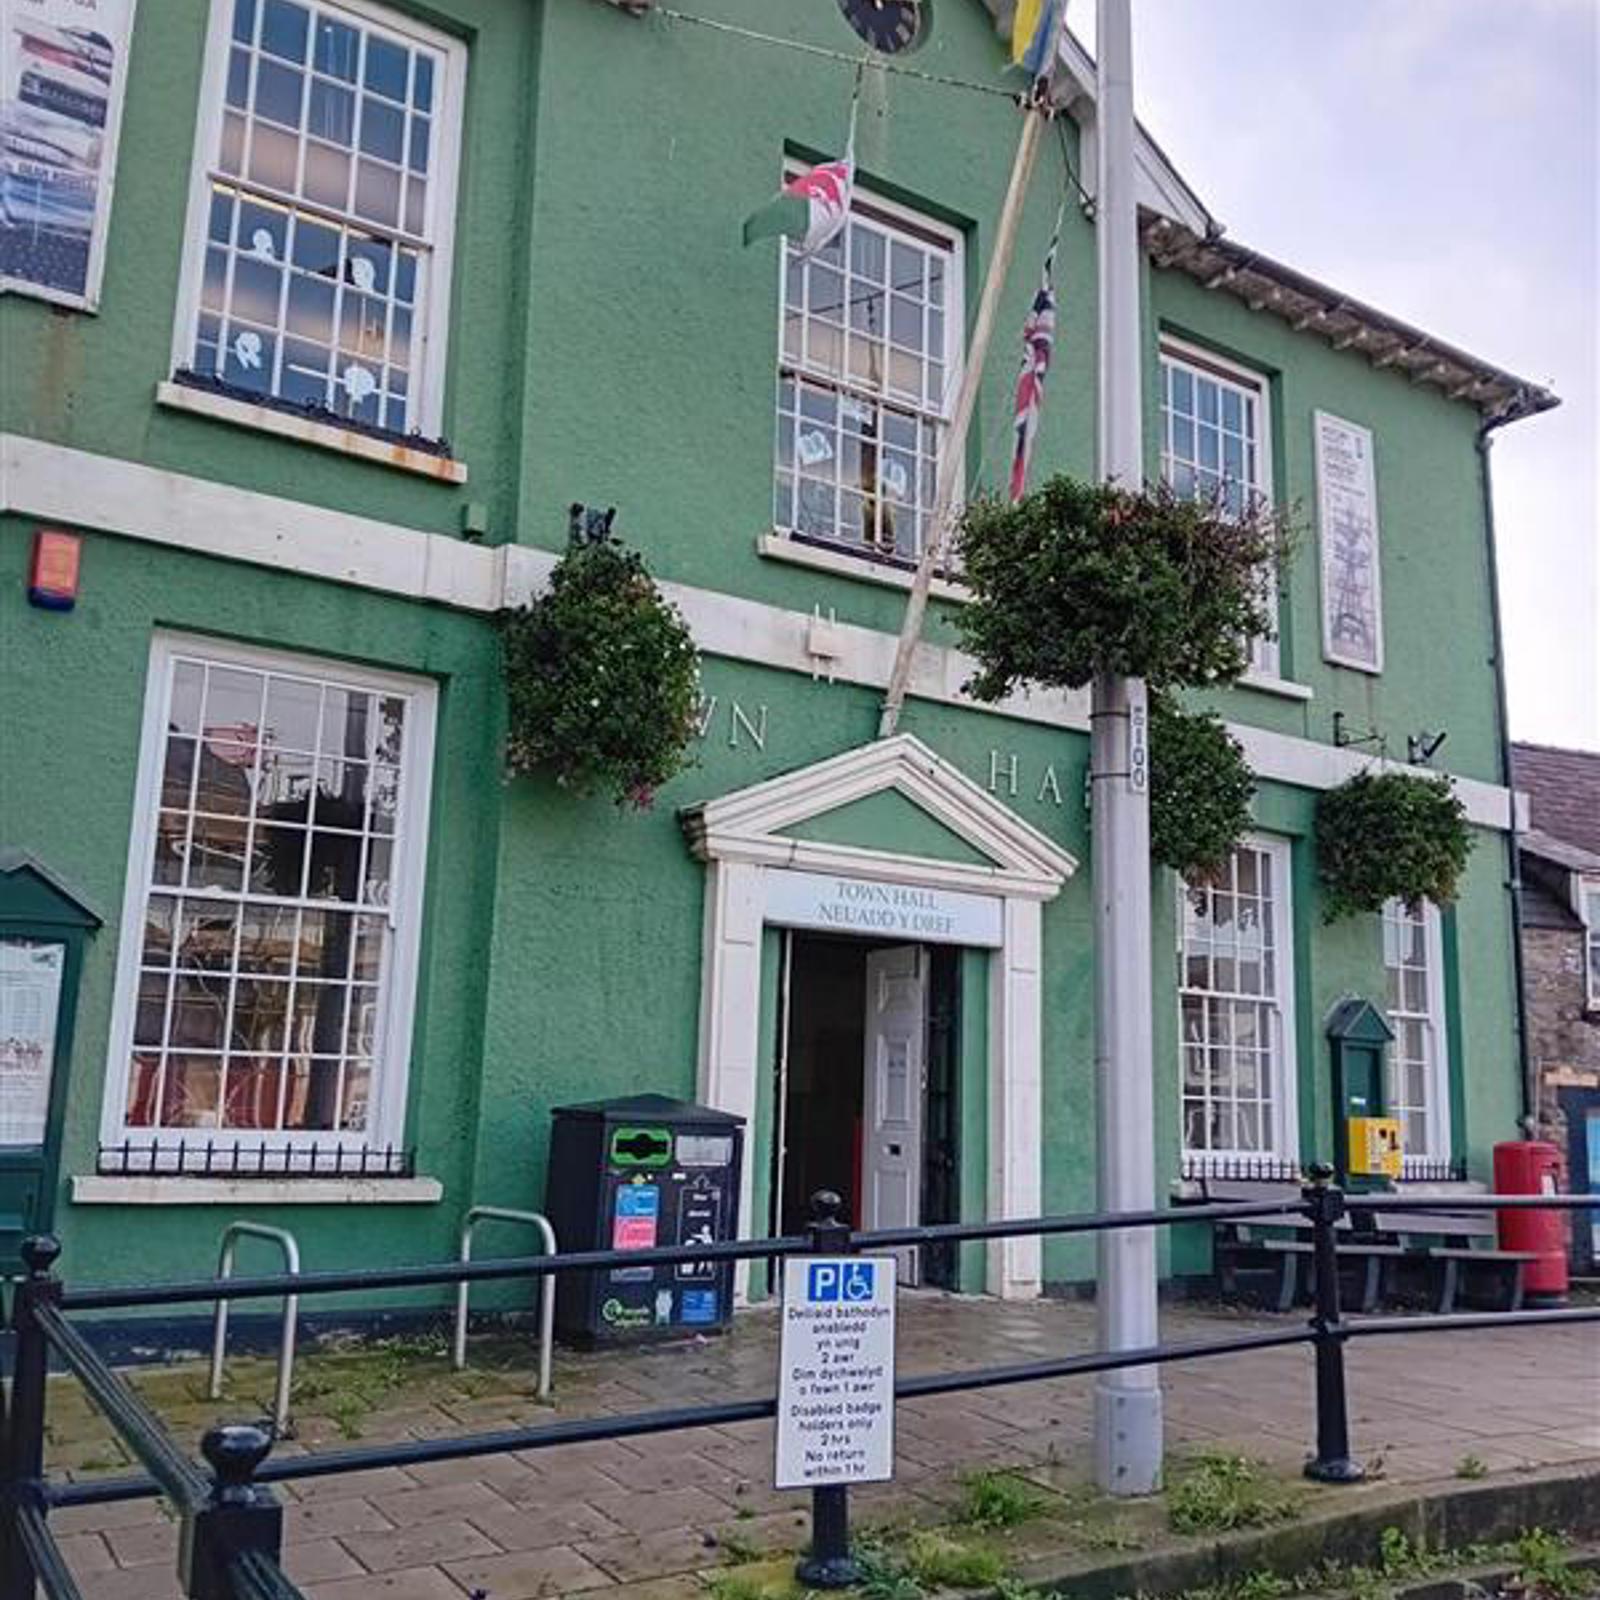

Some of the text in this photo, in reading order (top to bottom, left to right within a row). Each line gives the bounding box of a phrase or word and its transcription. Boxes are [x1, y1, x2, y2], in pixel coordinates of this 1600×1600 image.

[835, 881, 939, 910] TOWN HALL
[818, 903, 956, 934] NEUADD Y DREF
[814, 1267, 836, 1299] P
[816, 1339, 832, 1352] yn
[821, 1351, 830, 1364] 2
[791, 1367, 817, 1381] Dim
[790, 1401, 882, 1417] Disabled badge
[798, 1418, 873, 1432] holders only
[805, 1448, 865, 1462] No return
[803, 1464, 842, 1478] within
